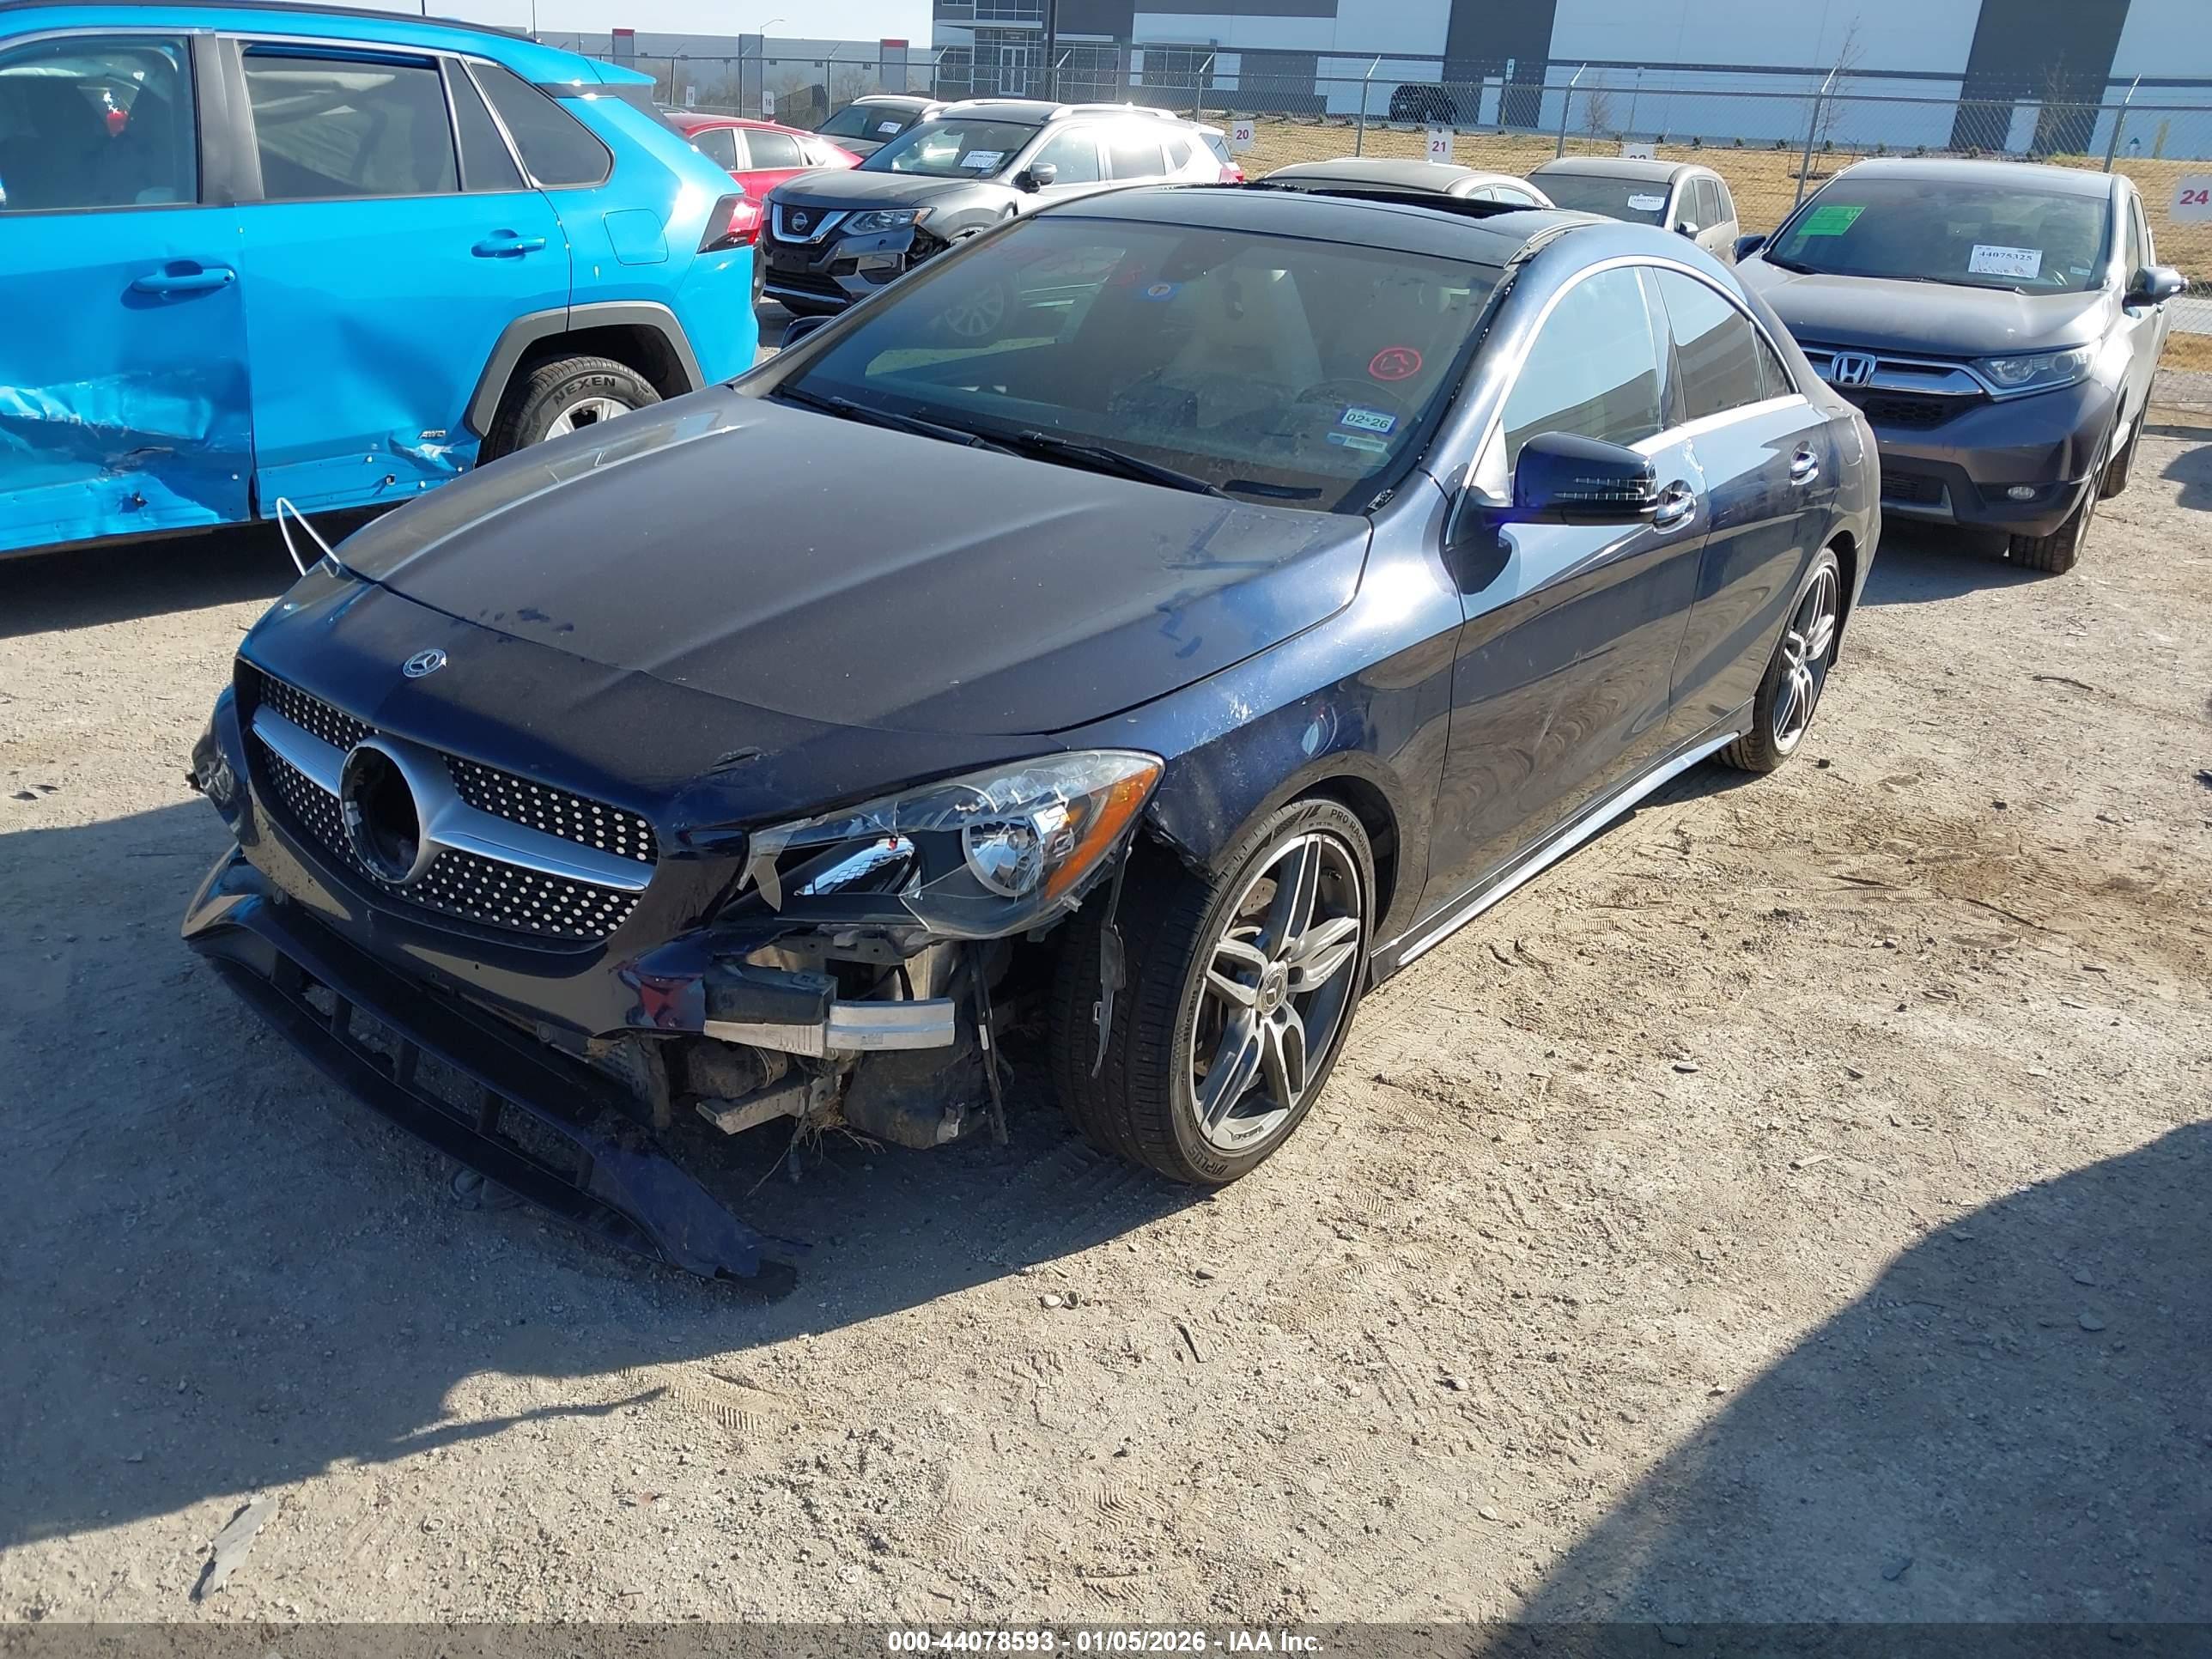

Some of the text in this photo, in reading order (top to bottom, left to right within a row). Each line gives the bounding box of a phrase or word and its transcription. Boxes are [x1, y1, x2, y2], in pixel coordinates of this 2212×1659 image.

[764, 99, 772, 107] 16
[1236, 129, 1249, 140] 20
[1431, 140, 1447, 152] 21
[2179, 189, 2209, 205] 24
[1978, 250, 2033, 262] 44075325
[552, 376, 616, 405] NEXEN
[1330, 809, 1349, 824] PRO
